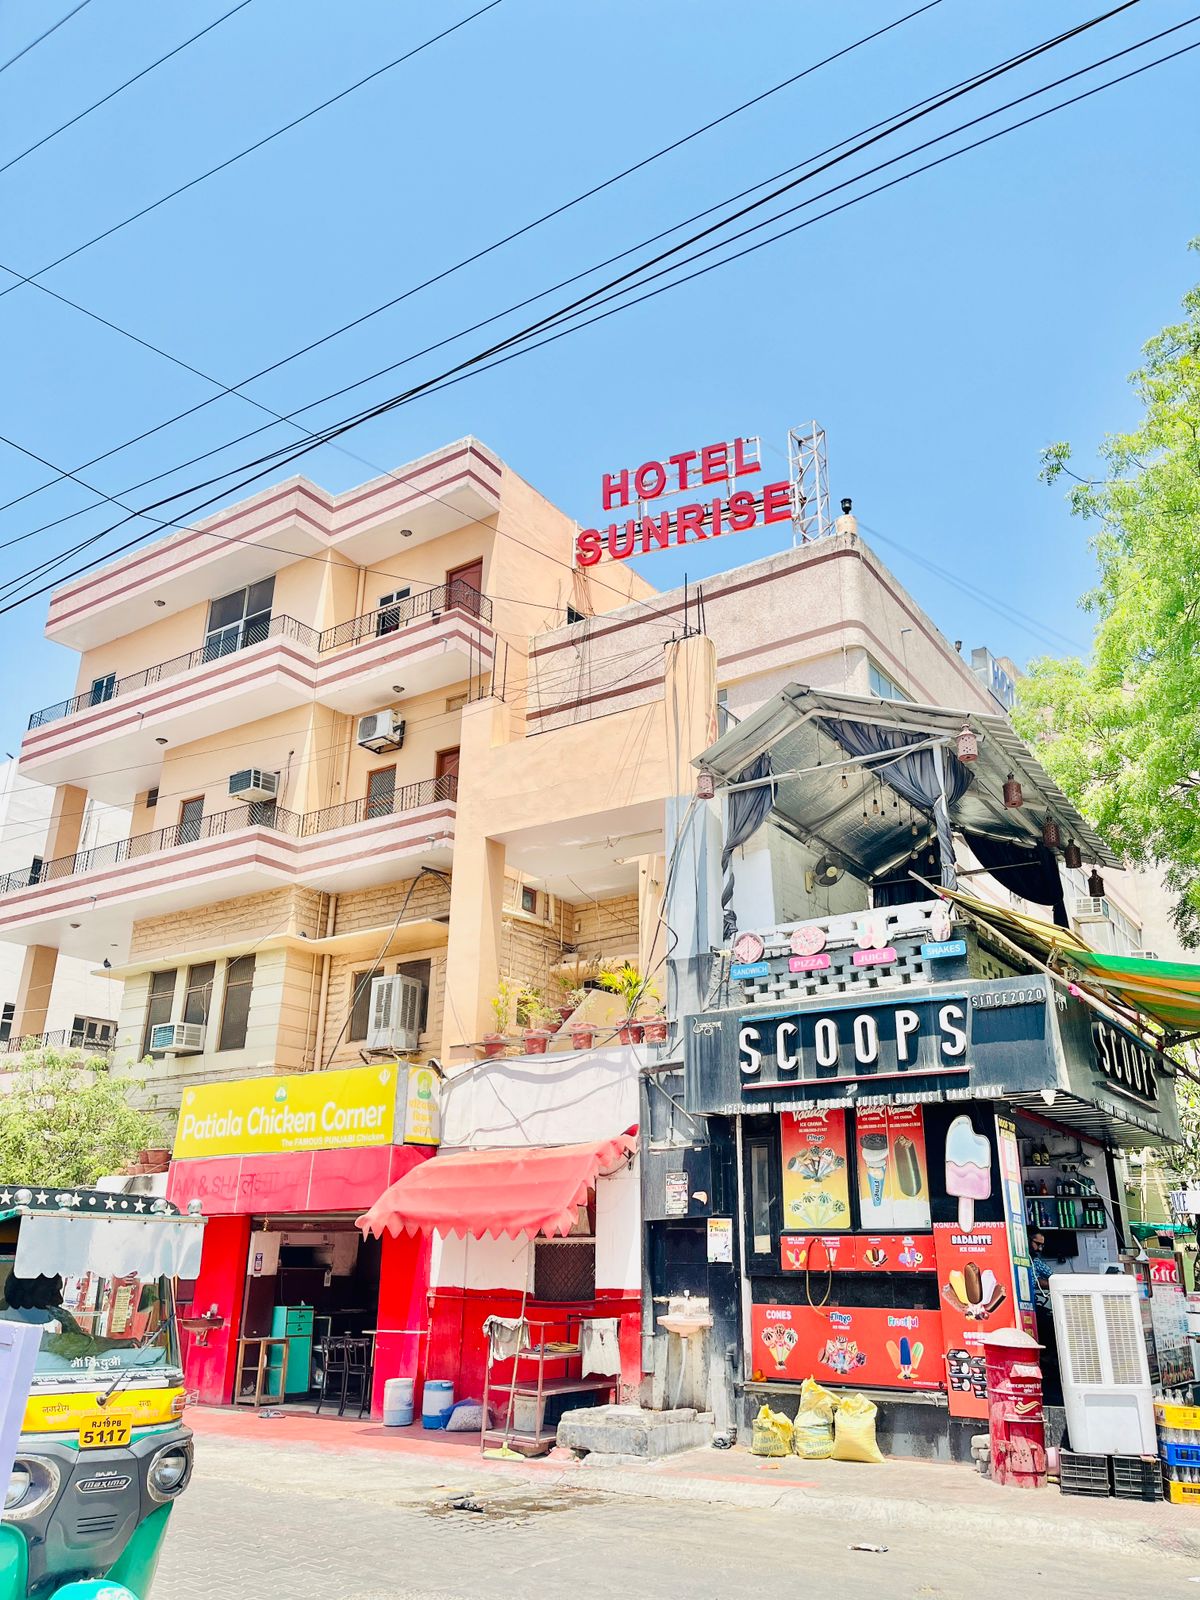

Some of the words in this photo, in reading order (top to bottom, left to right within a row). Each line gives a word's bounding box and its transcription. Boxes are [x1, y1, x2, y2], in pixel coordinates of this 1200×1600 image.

[602, 437, 761, 511] HOTEL
[575, 480, 793, 567] SUNRISE
[926, 944, 961, 956] SHAKES
[793, 958, 824, 969] PIZZA
[858, 951, 890, 963] JUICE
[732, 965, 768, 977] SANDWICH
[738, 1004, 969, 1075] SCOOPS
[1098, 1020, 1160, 1101] SCOOPS
[181, 1110, 243, 1141] Patiala
[247, 1105, 317, 1136] Chicken
[321, 1101, 386, 1131] Corner
[765, 1310, 792, 1320] CONES
[91, 1420, 102, 1428] RJ
[103, 1419, 111, 1428] 19
[112, 1419, 122, 1427] PB
[83, 1429, 127, 1444] 5117
